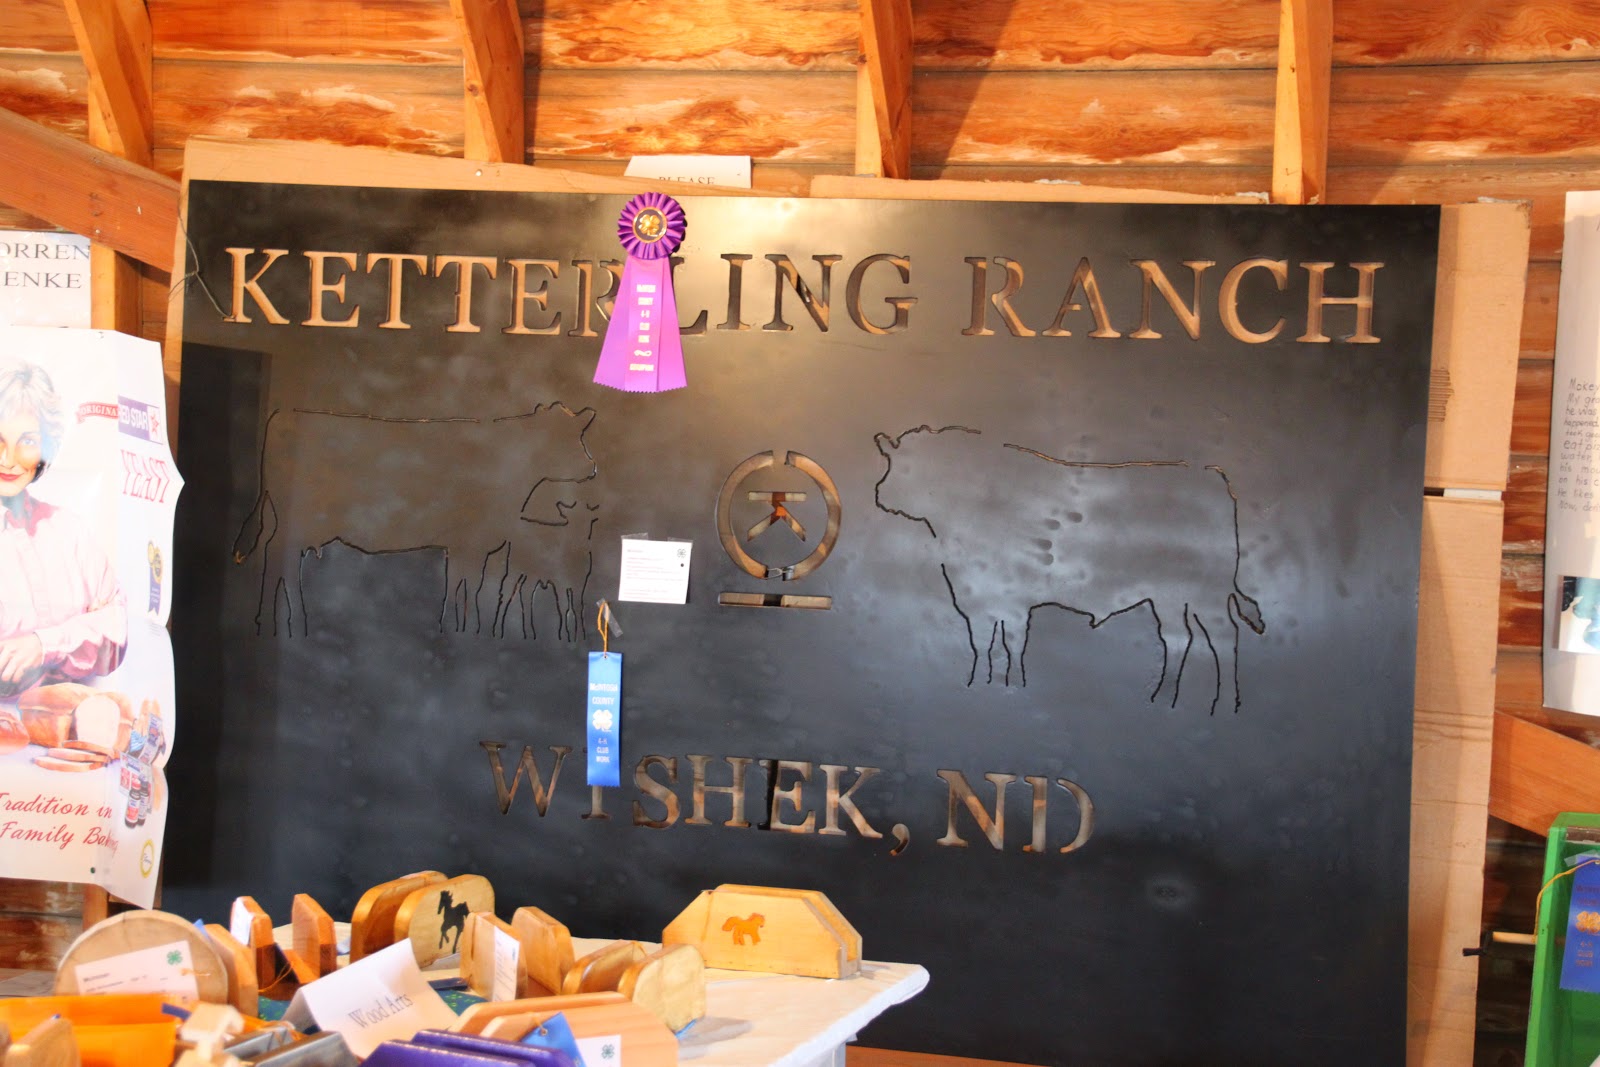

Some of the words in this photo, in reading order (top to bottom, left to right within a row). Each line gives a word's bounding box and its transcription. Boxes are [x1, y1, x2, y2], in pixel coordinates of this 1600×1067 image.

[961, 256, 1384, 345] RANCH
[120, 448, 171, 504] YEAST
[592, 697, 615, 705] COUNTY
[96, 803, 113, 819] in
[936, 768, 1096, 855] ND
[0, 821, 75, 850] Family
[347, 999, 391, 1029] Wood
[385, 993, 414, 1014] Arts
